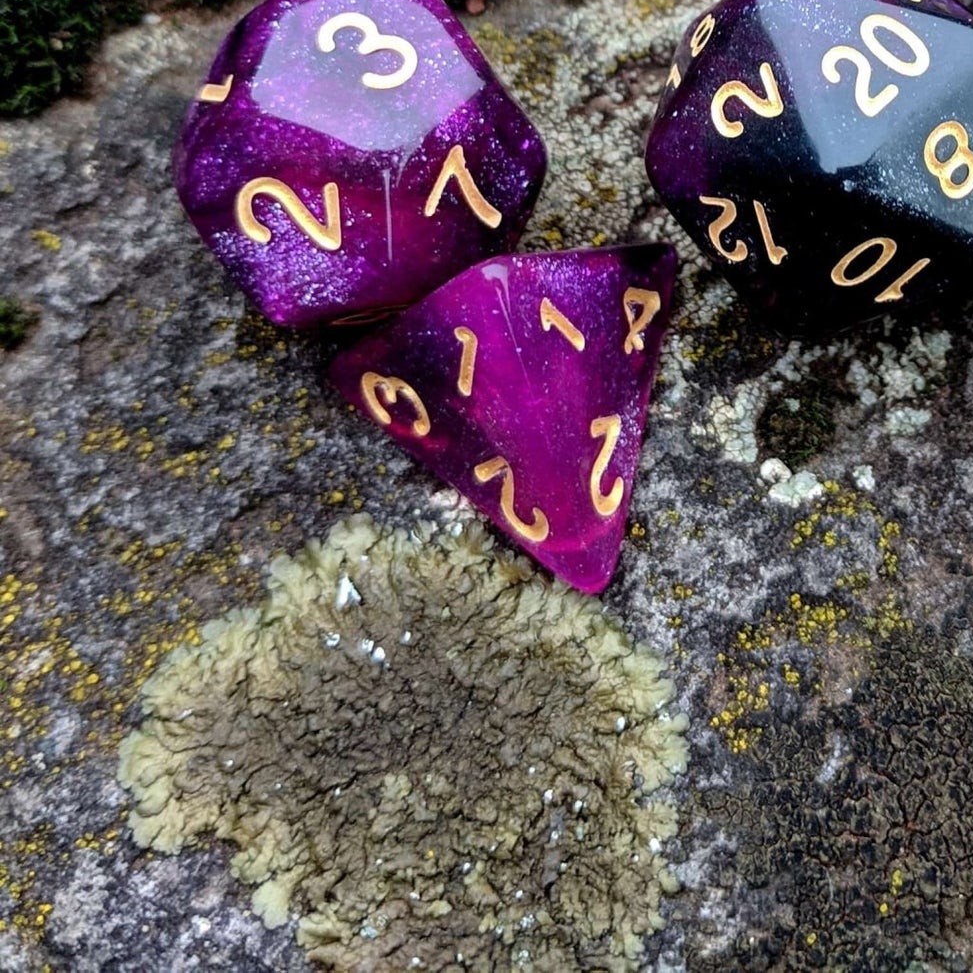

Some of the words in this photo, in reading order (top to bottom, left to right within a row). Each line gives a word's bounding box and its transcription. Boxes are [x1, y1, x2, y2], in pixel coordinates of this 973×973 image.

[317, 12, 418, 90] 3
[821, 14, 930, 117] 20
[711, 62, 784, 138] 2
[235, 176, 342, 250] 2
[699, 196, 788, 265] 12
[830, 237, 931, 303] 10
[540, 298, 586, 351] 1
[623, 287, 661, 355] 4
[454, 327, 479, 397] 1
[360, 371, 431, 437] 3
[474, 455, 549, 541] 2
[591, 415, 625, 516] 2
